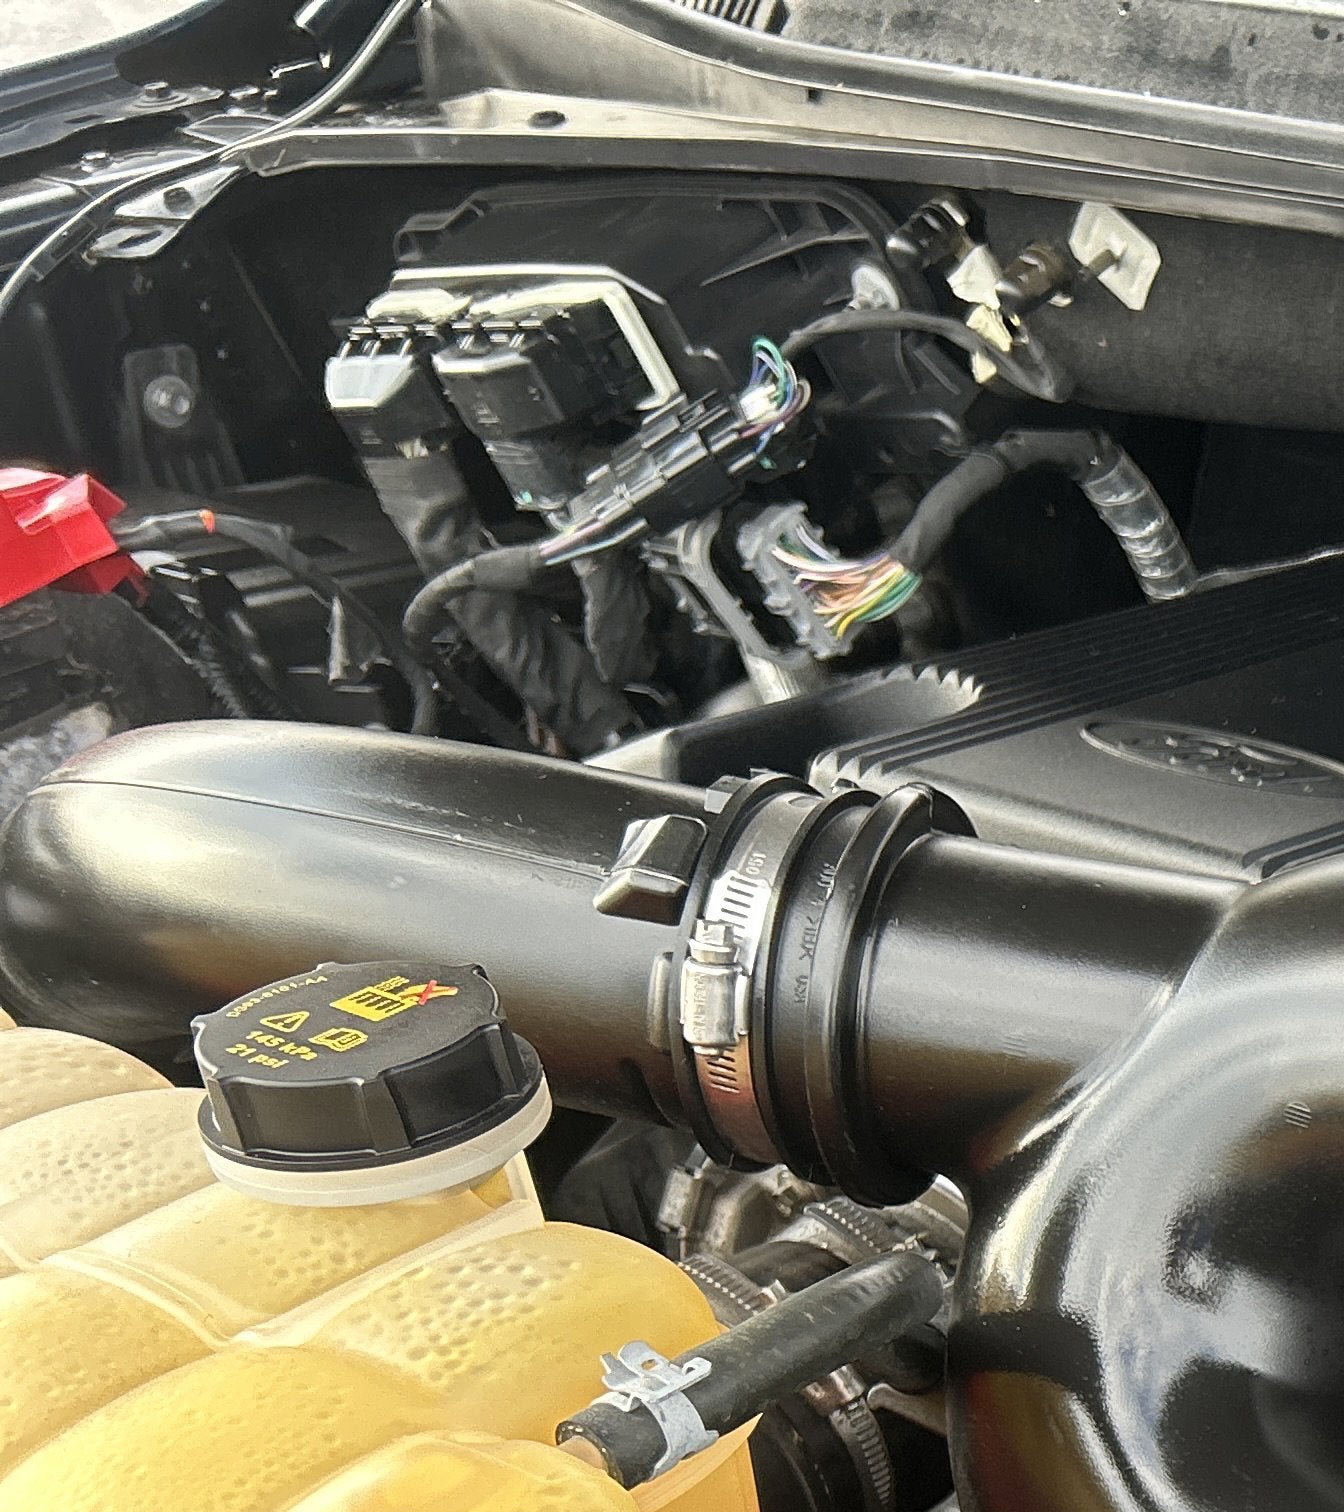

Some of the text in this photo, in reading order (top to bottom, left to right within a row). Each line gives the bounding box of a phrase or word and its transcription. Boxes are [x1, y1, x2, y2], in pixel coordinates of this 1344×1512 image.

[225, 1043, 290, 1070] 21 psi
[245, 1030, 318, 1061] 145 kPa
